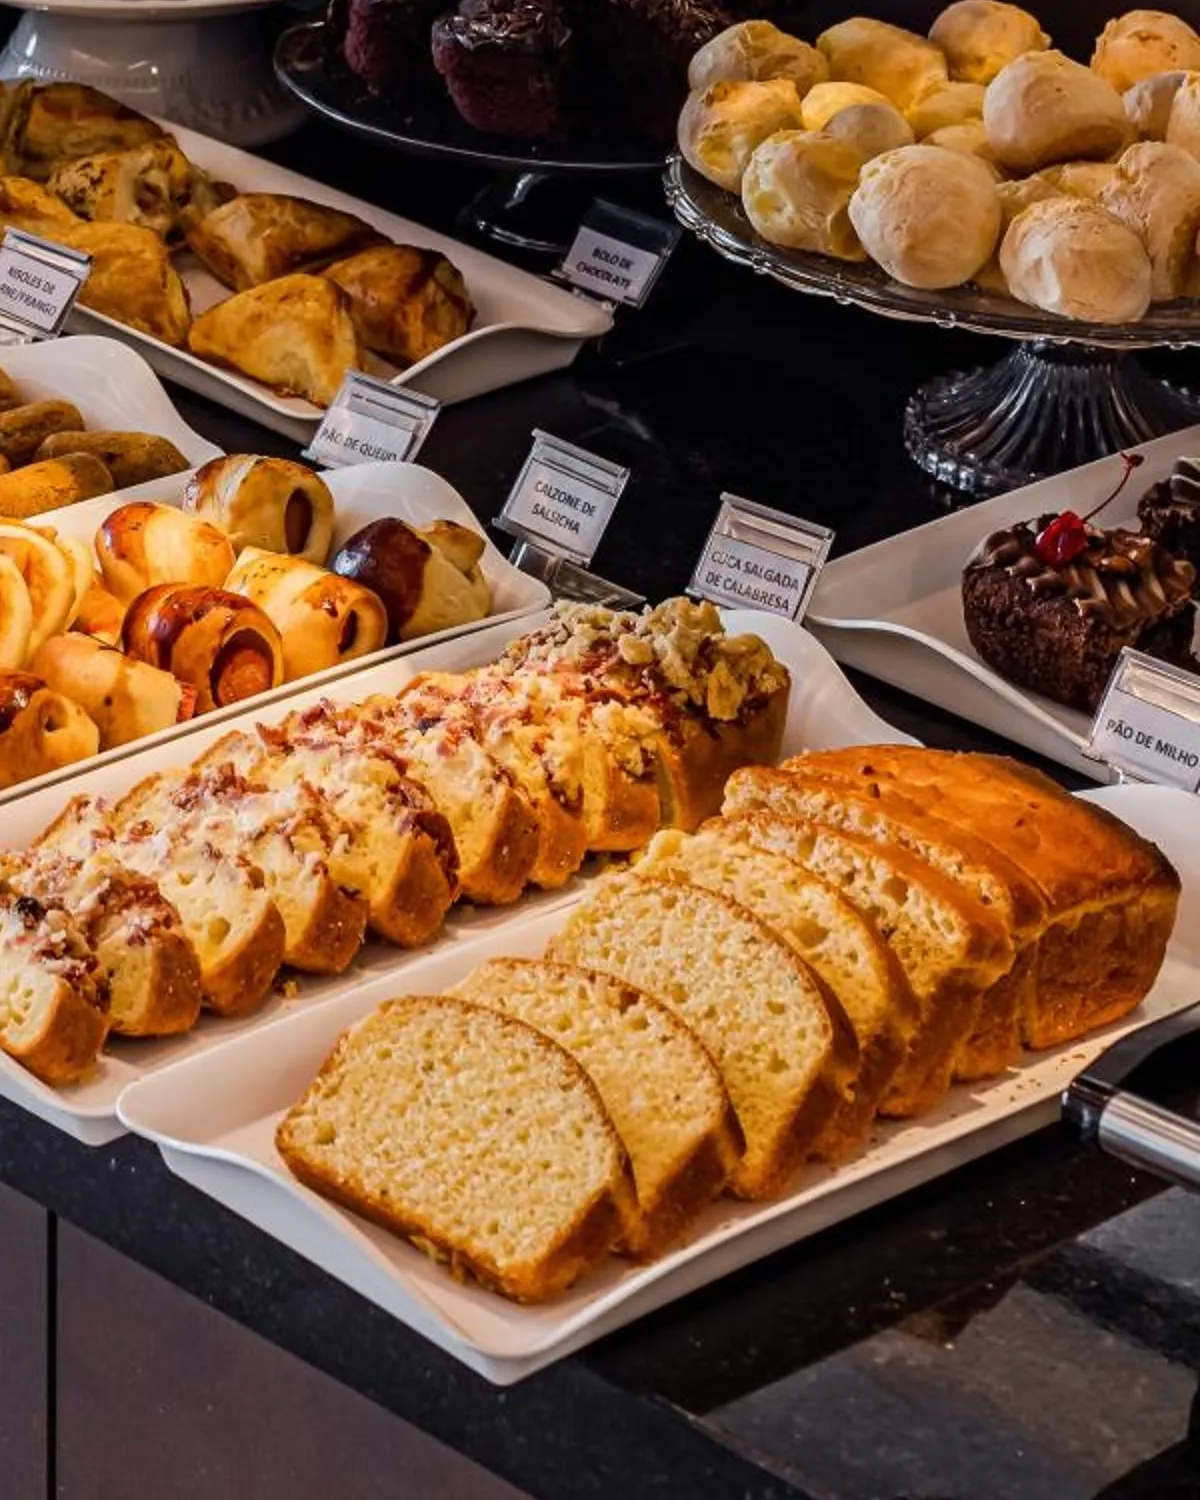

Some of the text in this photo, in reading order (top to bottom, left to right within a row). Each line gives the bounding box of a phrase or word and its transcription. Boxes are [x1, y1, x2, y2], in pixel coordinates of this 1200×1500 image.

[343, 436, 360, 451] DE
[531, 502, 580, 534] SALSICHA
[534, 480, 597, 517] CALZONE DE
[711, 550, 800, 592] CUCA SALGADA
[705, 570, 790, 613] DE CALABRESA
[1106, 717, 1200, 768] PÃO DE MILHO
